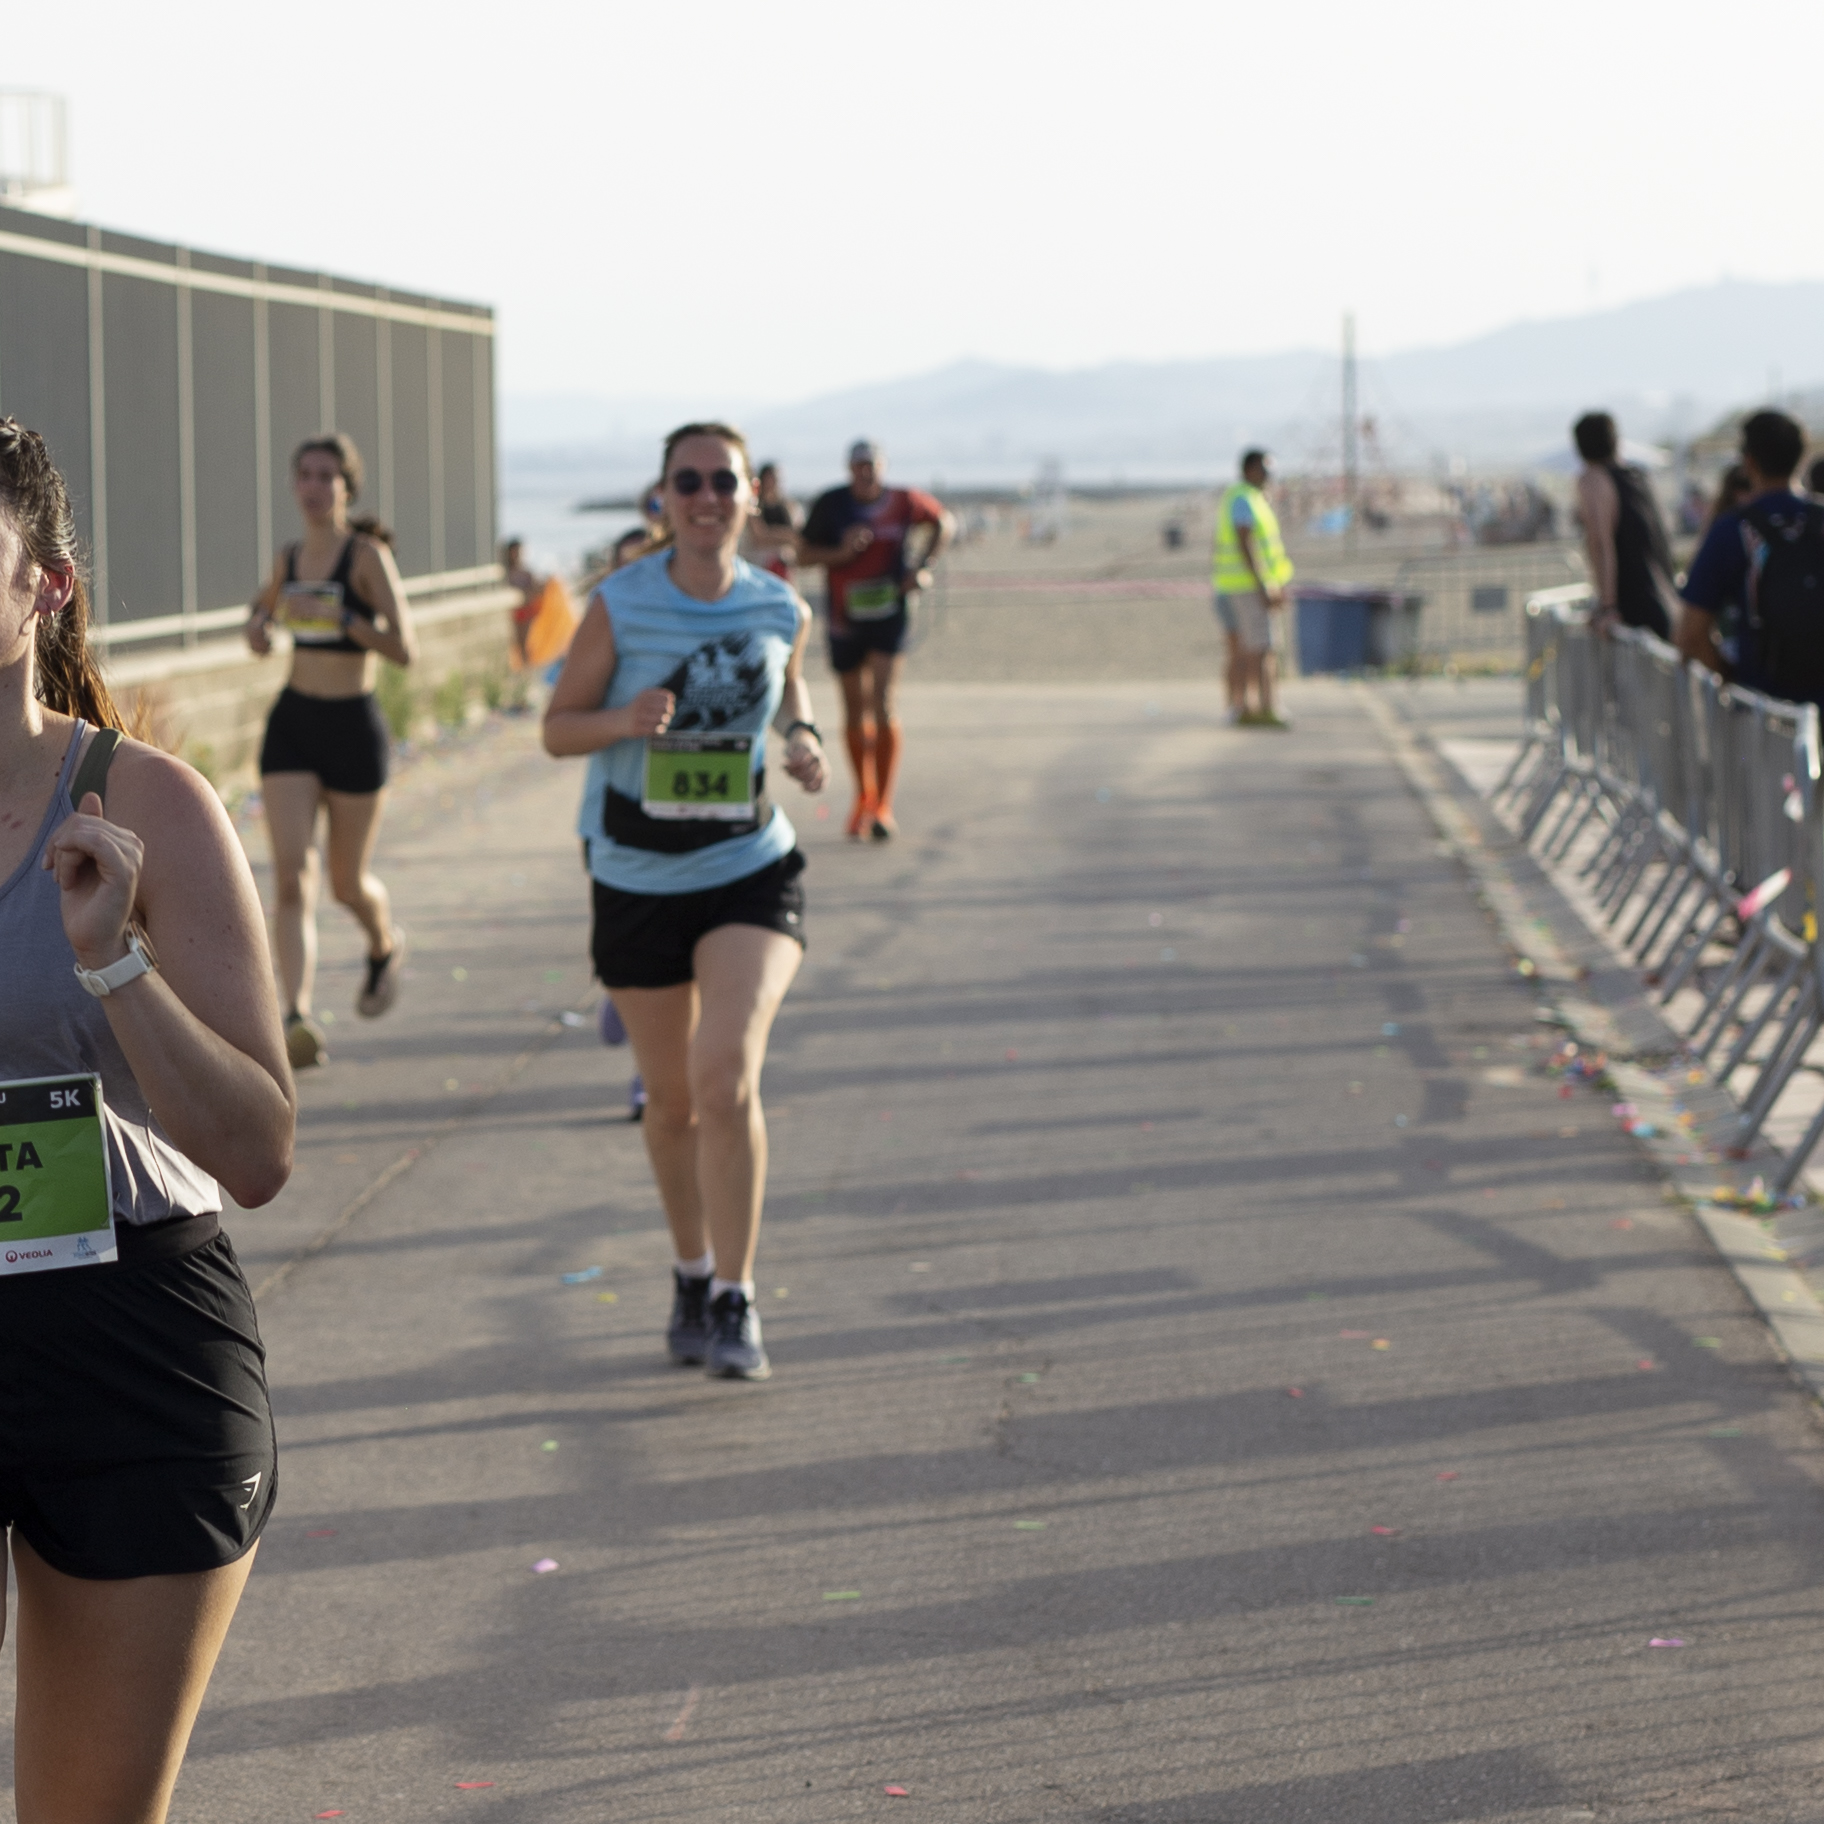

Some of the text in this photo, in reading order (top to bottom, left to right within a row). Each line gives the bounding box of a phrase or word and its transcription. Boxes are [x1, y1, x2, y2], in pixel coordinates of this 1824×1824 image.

[672, 770, 729, 797] 834
[49, 1088, 81, 1109] 5K
[19, 1249, 53, 1260] VEOLIA
